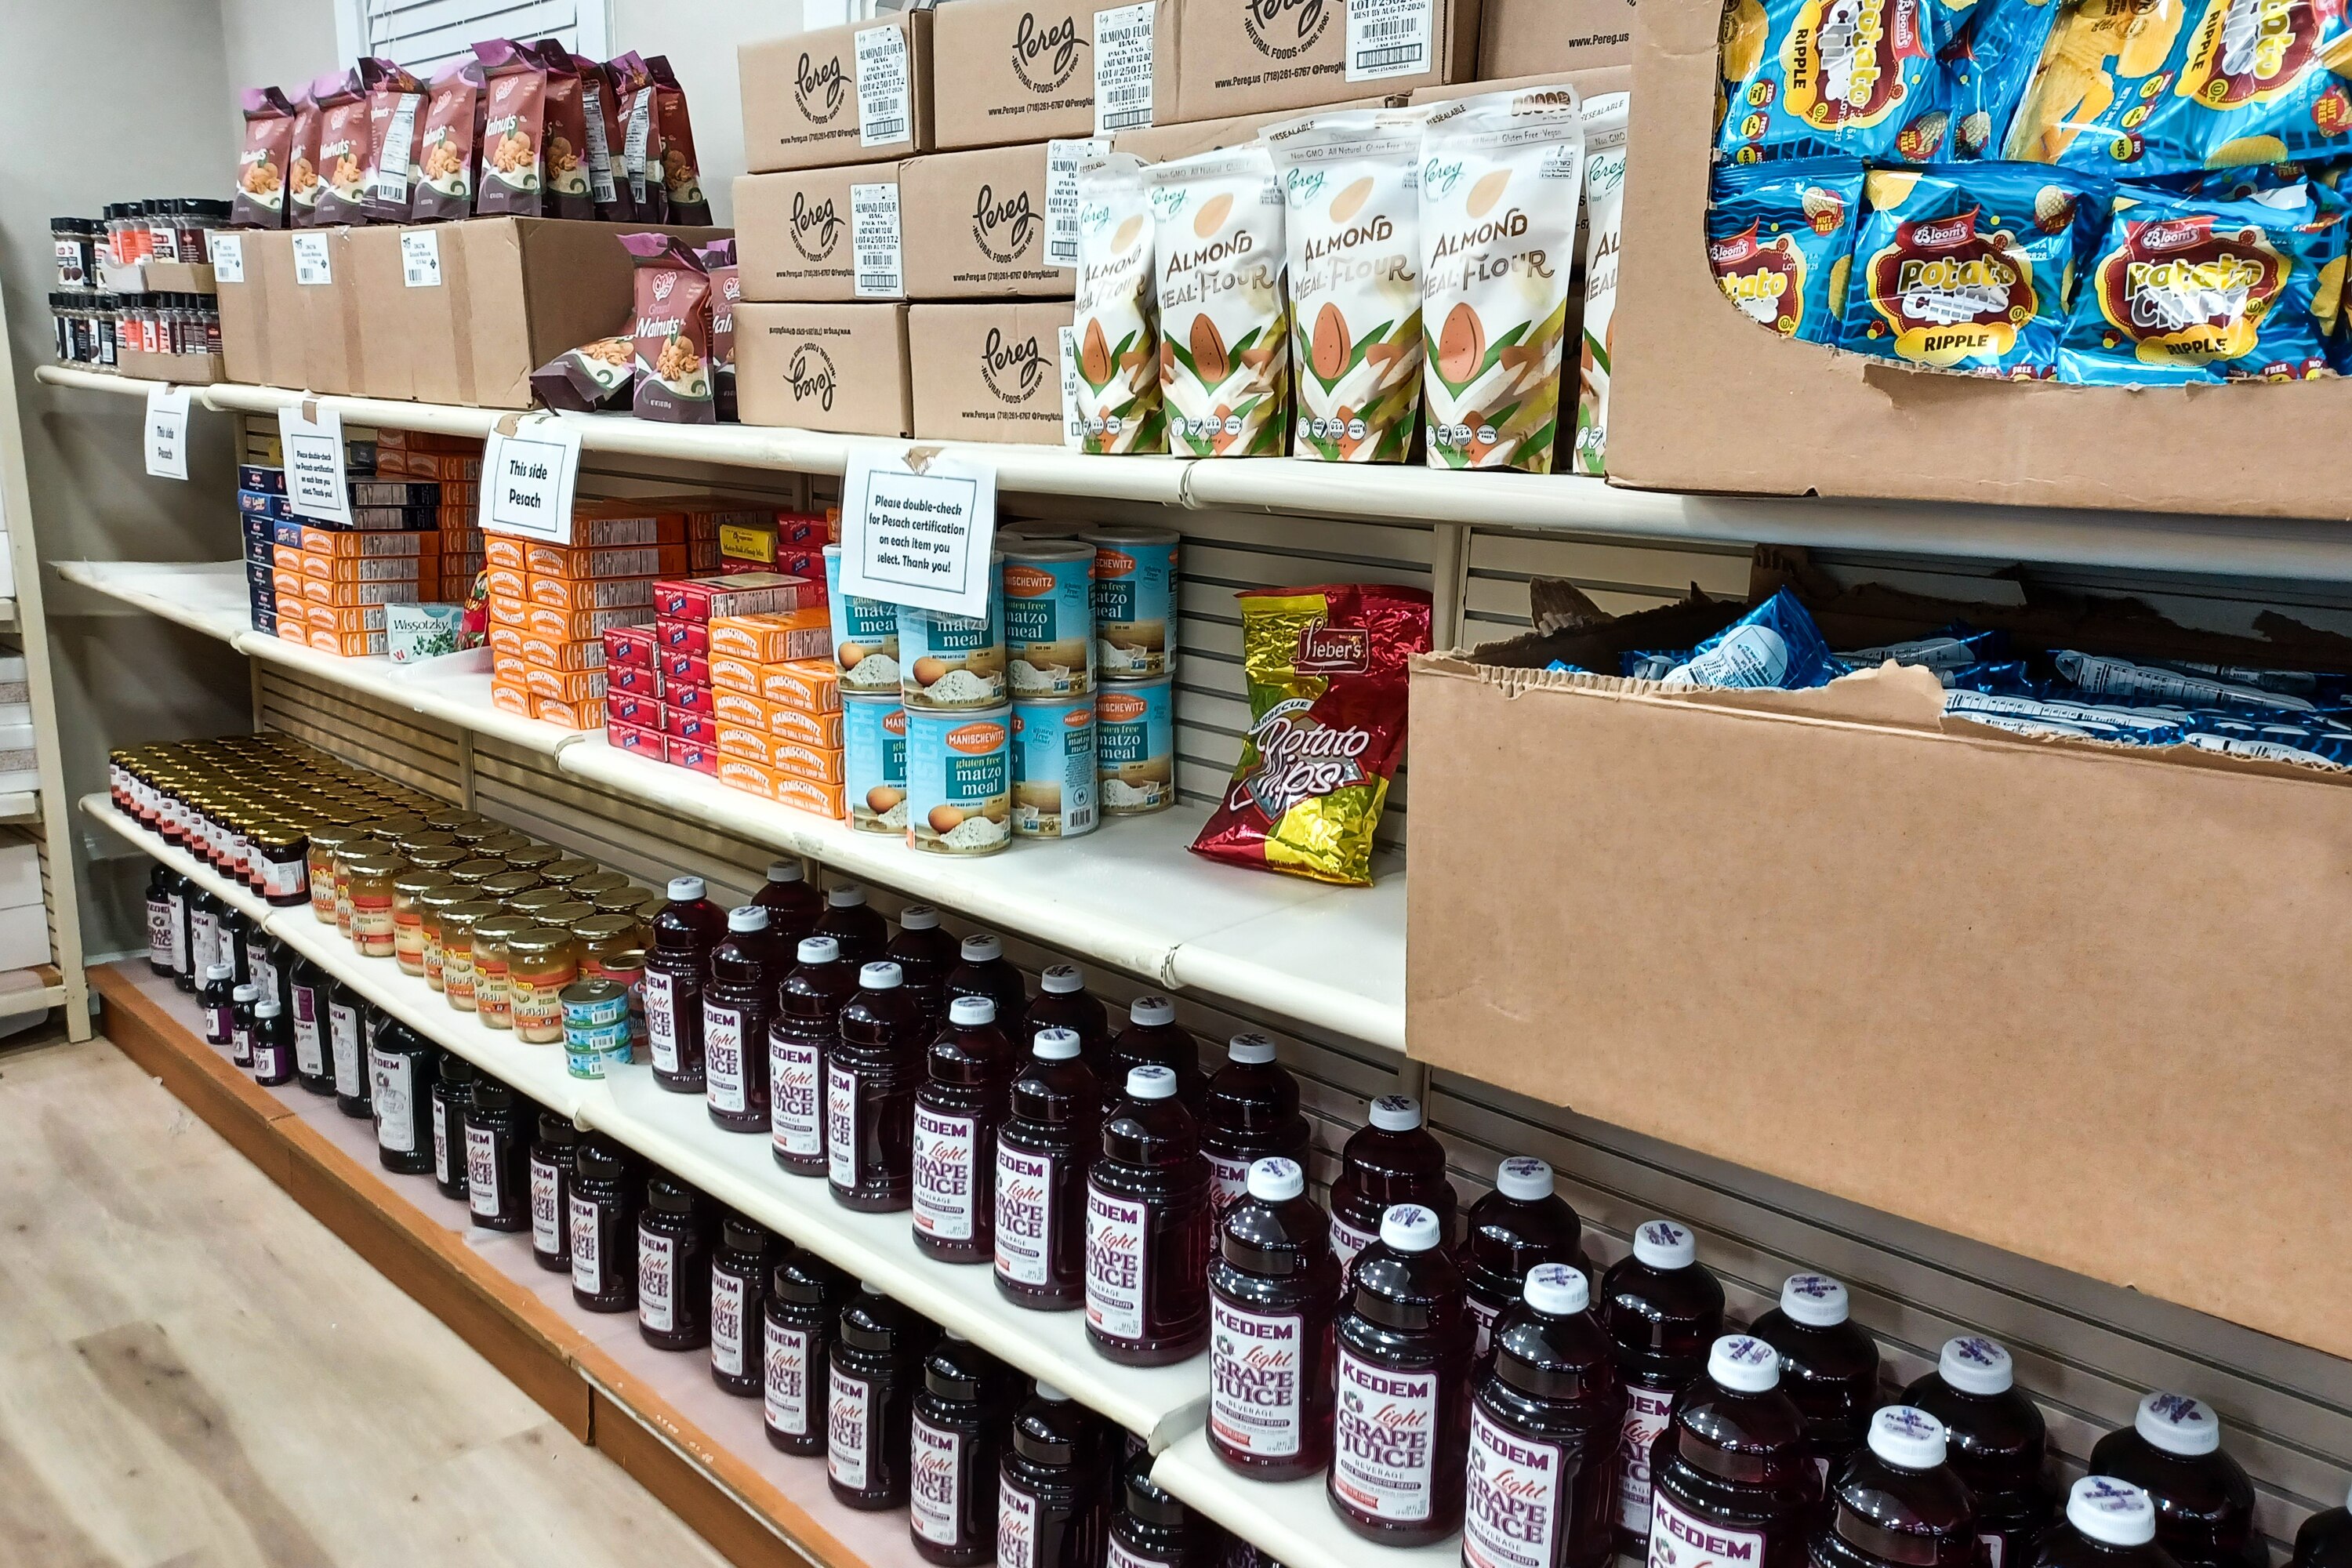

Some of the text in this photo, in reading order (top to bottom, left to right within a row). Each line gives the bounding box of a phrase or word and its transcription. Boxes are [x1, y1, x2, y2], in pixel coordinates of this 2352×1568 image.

[1011, 13, 1090, 74] Pereg
[1099, 29, 1131, 44] ALMOND
[1245, 17, 1270, 57] NATURAL
[1271, 47, 1298, 59] FOODS
[1301, 34, 1319, 53] SINCE
[1317, 14, 1330, 34] 1906
[1569, 32, 1630, 48] www.Pereg.us
[2190, 9, 2222, 72] RIPPLE
[860, 46, 882, 60] ALMOND
[1793, 28, 1809, 89] RIPPLE
[794, 53, 852, 109] Pereg
[1012, 56, 1033, 90] NATURAL
[1033, 81, 1054, 93] FOODS
[1215, 74, 1261, 89] www.Pereg.us
[794, 91, 829, 125] NATURAL FOODS
[989, 104, 1025, 116] www.Pereg.us
[1426, 103, 1467, 125] RESEALABLE
[2317, 99, 2328, 124] FREE
[2325, 98, 2337, 120] NUT
[1269, 121, 1316, 142] RESEALABLE
[1501, 129, 1562, 143] Gluten Free Vegan
[1900, 131, 1909, 152] FREE
[2117, 139, 2125, 158] MSG
[1287, 169, 1328, 200] Pereg
[1424, 157, 1465, 193] Pereg
[790, 191, 846, 248] Pereg
[973, 184, 1044, 247] Pereg
[1815, 223, 1834, 233] FREE
[1816, 216, 1833, 225] NUT
[972, 227, 1012, 263] NATURAL FOODS
[1305, 214, 1393, 271] ALMOND
[1431, 208, 1528, 270] ALMOND
[1912, 221, 1968, 248] Bloom's
[2142, 226, 2201, 249] Bloom's
[1167, 230, 1253, 283] ALMOND
[1899, 254, 2016, 292] Potato
[635, 316, 680, 339] Walnuts
[1924, 334, 1990, 352] RIPPLE
[2165, 337, 2227, 356] RIPPLE
[982, 327, 1052, 389] Pereg
[982, 366, 1021, 404] NATURAL FOODS
[510, 459, 547, 481] This side
[509, 488, 541, 509] Pesach
[875, 495, 962, 516] Please double-check
[869, 513, 965, 536] for Pesach certification
[879, 535, 950, 554] on each item you
[877, 553, 951, 574] select. Thank you!
[394, 618, 448, 633] Wissotzky
[942, 630, 983, 648] meal
[1289, 616, 1366, 667] Lieber's
[949, 729, 1004, 746] MANISCHEWITZ
[1256, 717, 1370, 772] Potato
[956, 756, 1001, 771] gluten free
[1100, 746, 1136, 760] meal
[956, 765, 1002, 782] matzo
[962, 779, 998, 796] meal
[779, 1066, 812, 1086] Light
[929, 1140, 967, 1162] Light
[1006, 1178, 1043, 1203] Light
[1098, 1225, 1138, 1250] Light
[1214, 1305, 1294, 1341] KEDEM
[1213, 1350, 1294, 1390] GRAPE
[1242, 1344, 1294, 1371] Light
[1214, 1368, 1294, 1407] JUICE
[1343, 1359, 1429, 1399] KEDEM
[1228, 1398, 1274, 1418] BEVERAGE
[1372, 1402, 1428, 1430] Light
[1339, 1409, 1428, 1450] GRAPE
[1472, 1410, 1550, 1471] KEDEM
[1341, 1428, 1426, 1470] JUICE
[1354, 1459, 1406, 1480] BEVERAGE
[1467, 1465, 1548, 1526] GRAPE
[1492, 1468, 1548, 1500] Light
[1468, 1482, 1545, 1546] JUICE
[1656, 1500, 1751, 1560] KEDEM
